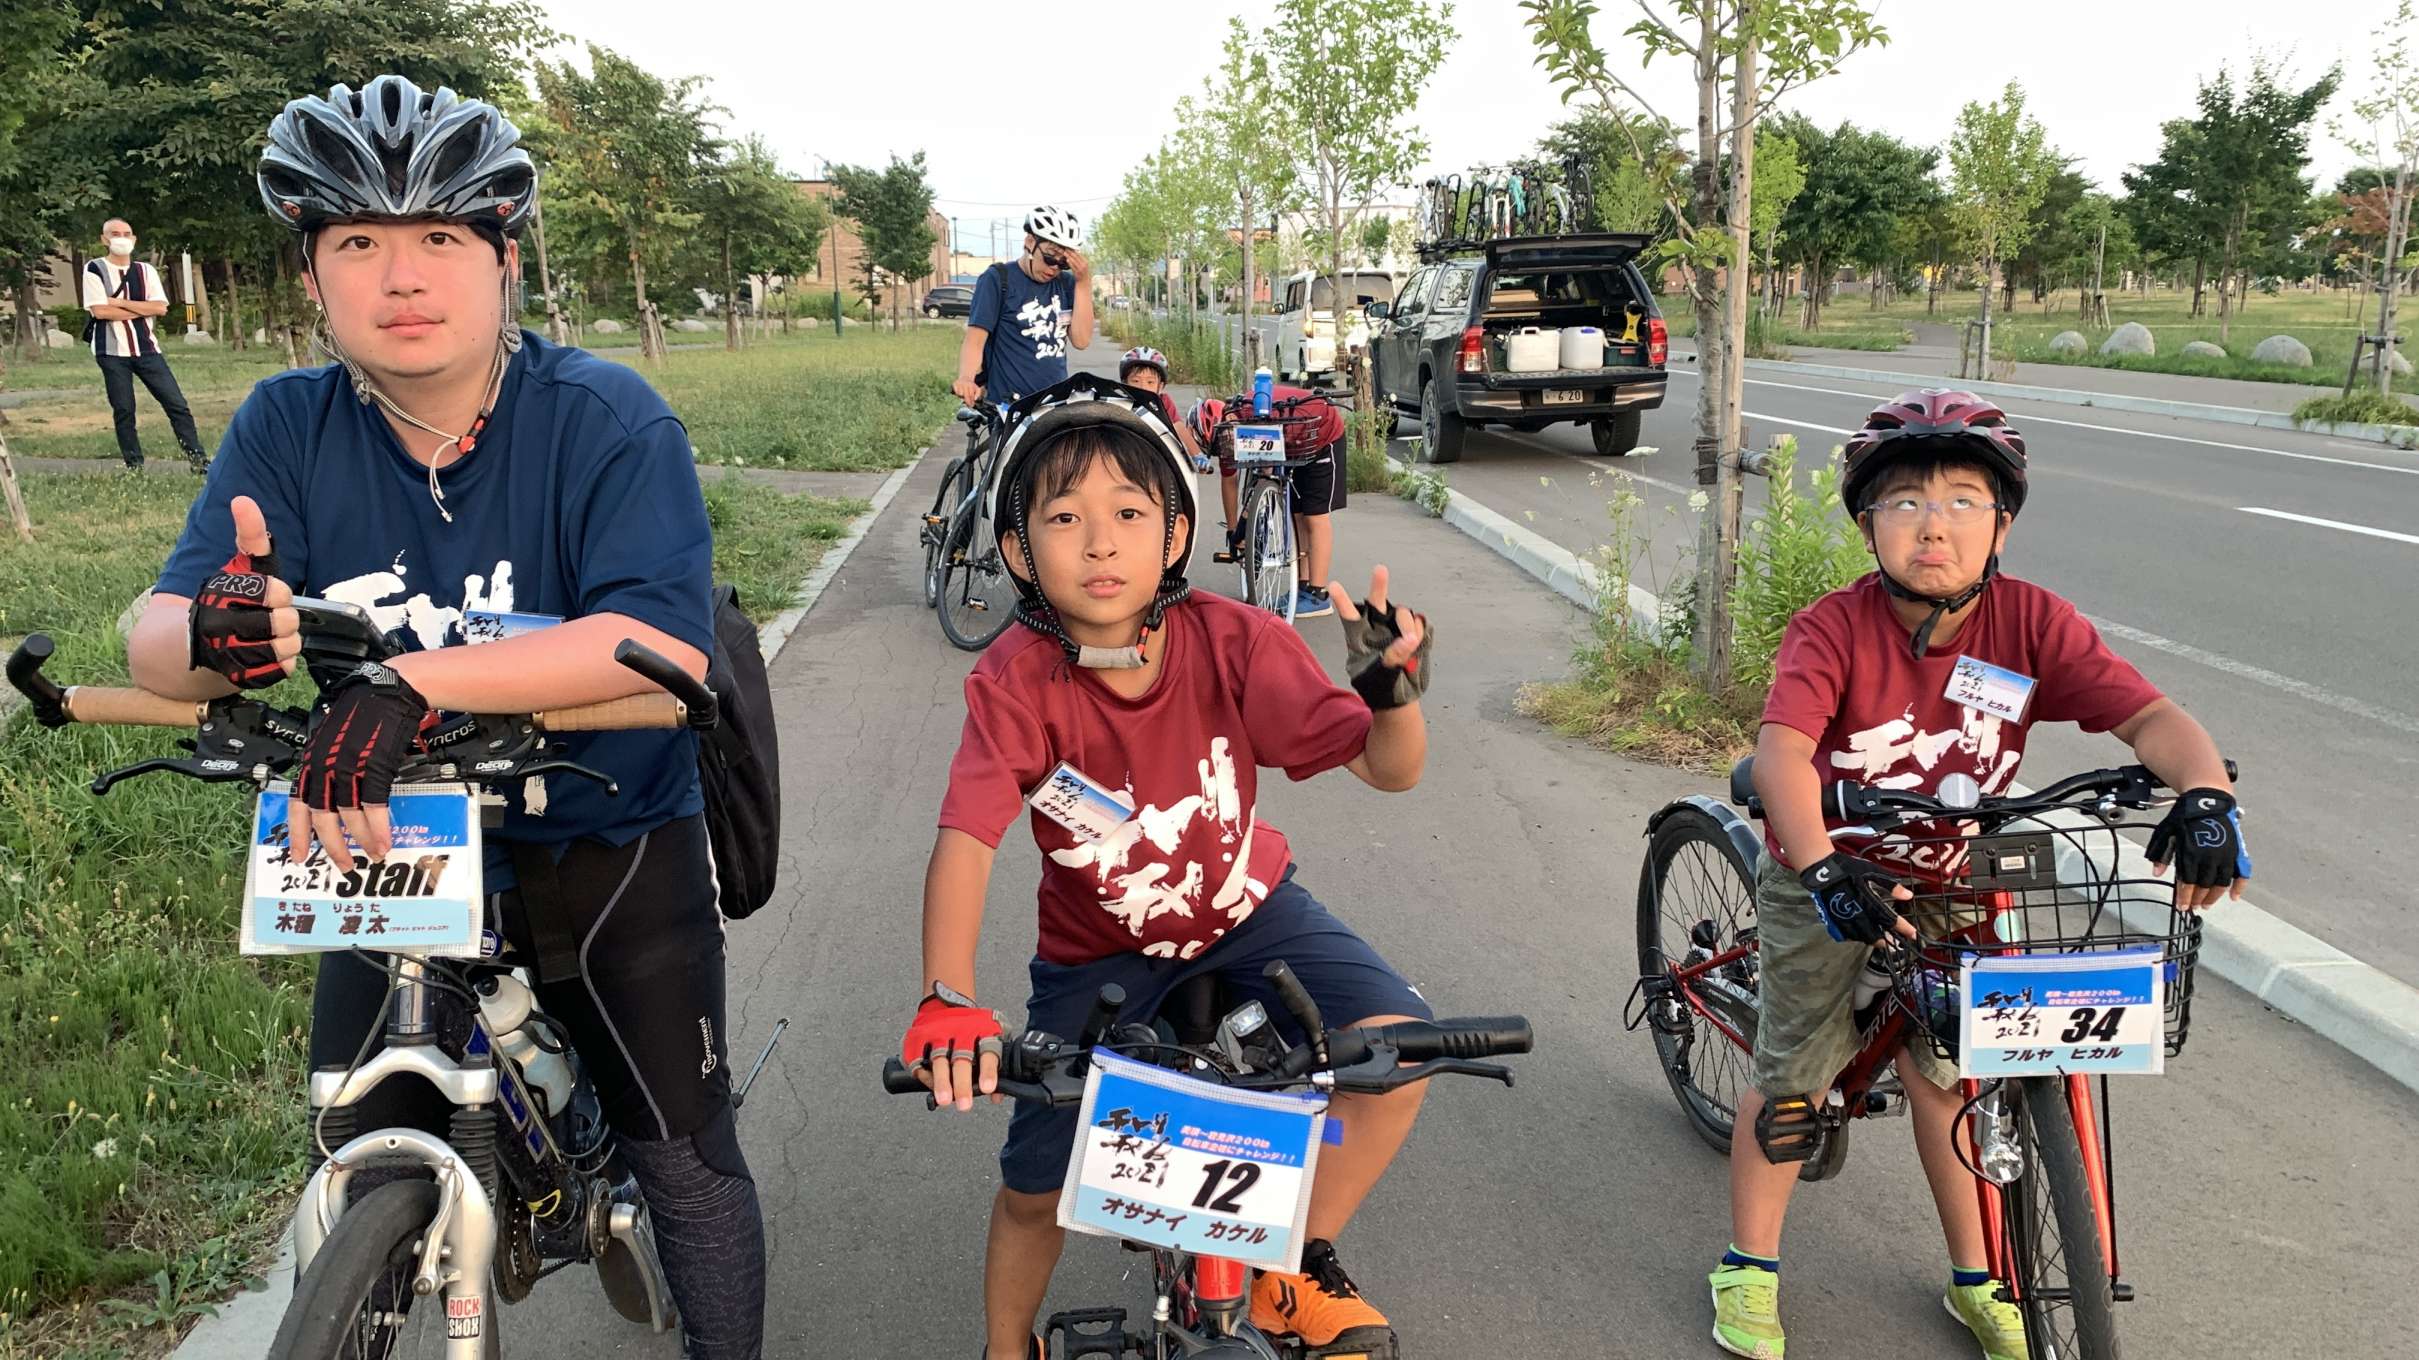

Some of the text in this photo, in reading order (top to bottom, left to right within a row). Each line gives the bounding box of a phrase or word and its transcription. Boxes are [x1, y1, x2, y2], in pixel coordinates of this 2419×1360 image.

[1259, 440, 1274, 451] 20
[207, 573, 267, 597] PRO
[1958, 689, 2012, 713] フルヤ ヒカル
[1039, 800, 1076, 823] オサナイ
[1075, 823, 1103, 840] カケル
[336, 853, 451, 899] Staff
[2061, 1007, 2127, 1043] 34
[2002, 1047, 2124, 1062] フルヤ ヒカル
[1191, 1159, 1262, 1216] 12
[1101, 1197, 1269, 1246] オサナイ カケル
[449, 1298, 480, 1317] ROCK
[449, 1317, 480, 1337] SHOX
